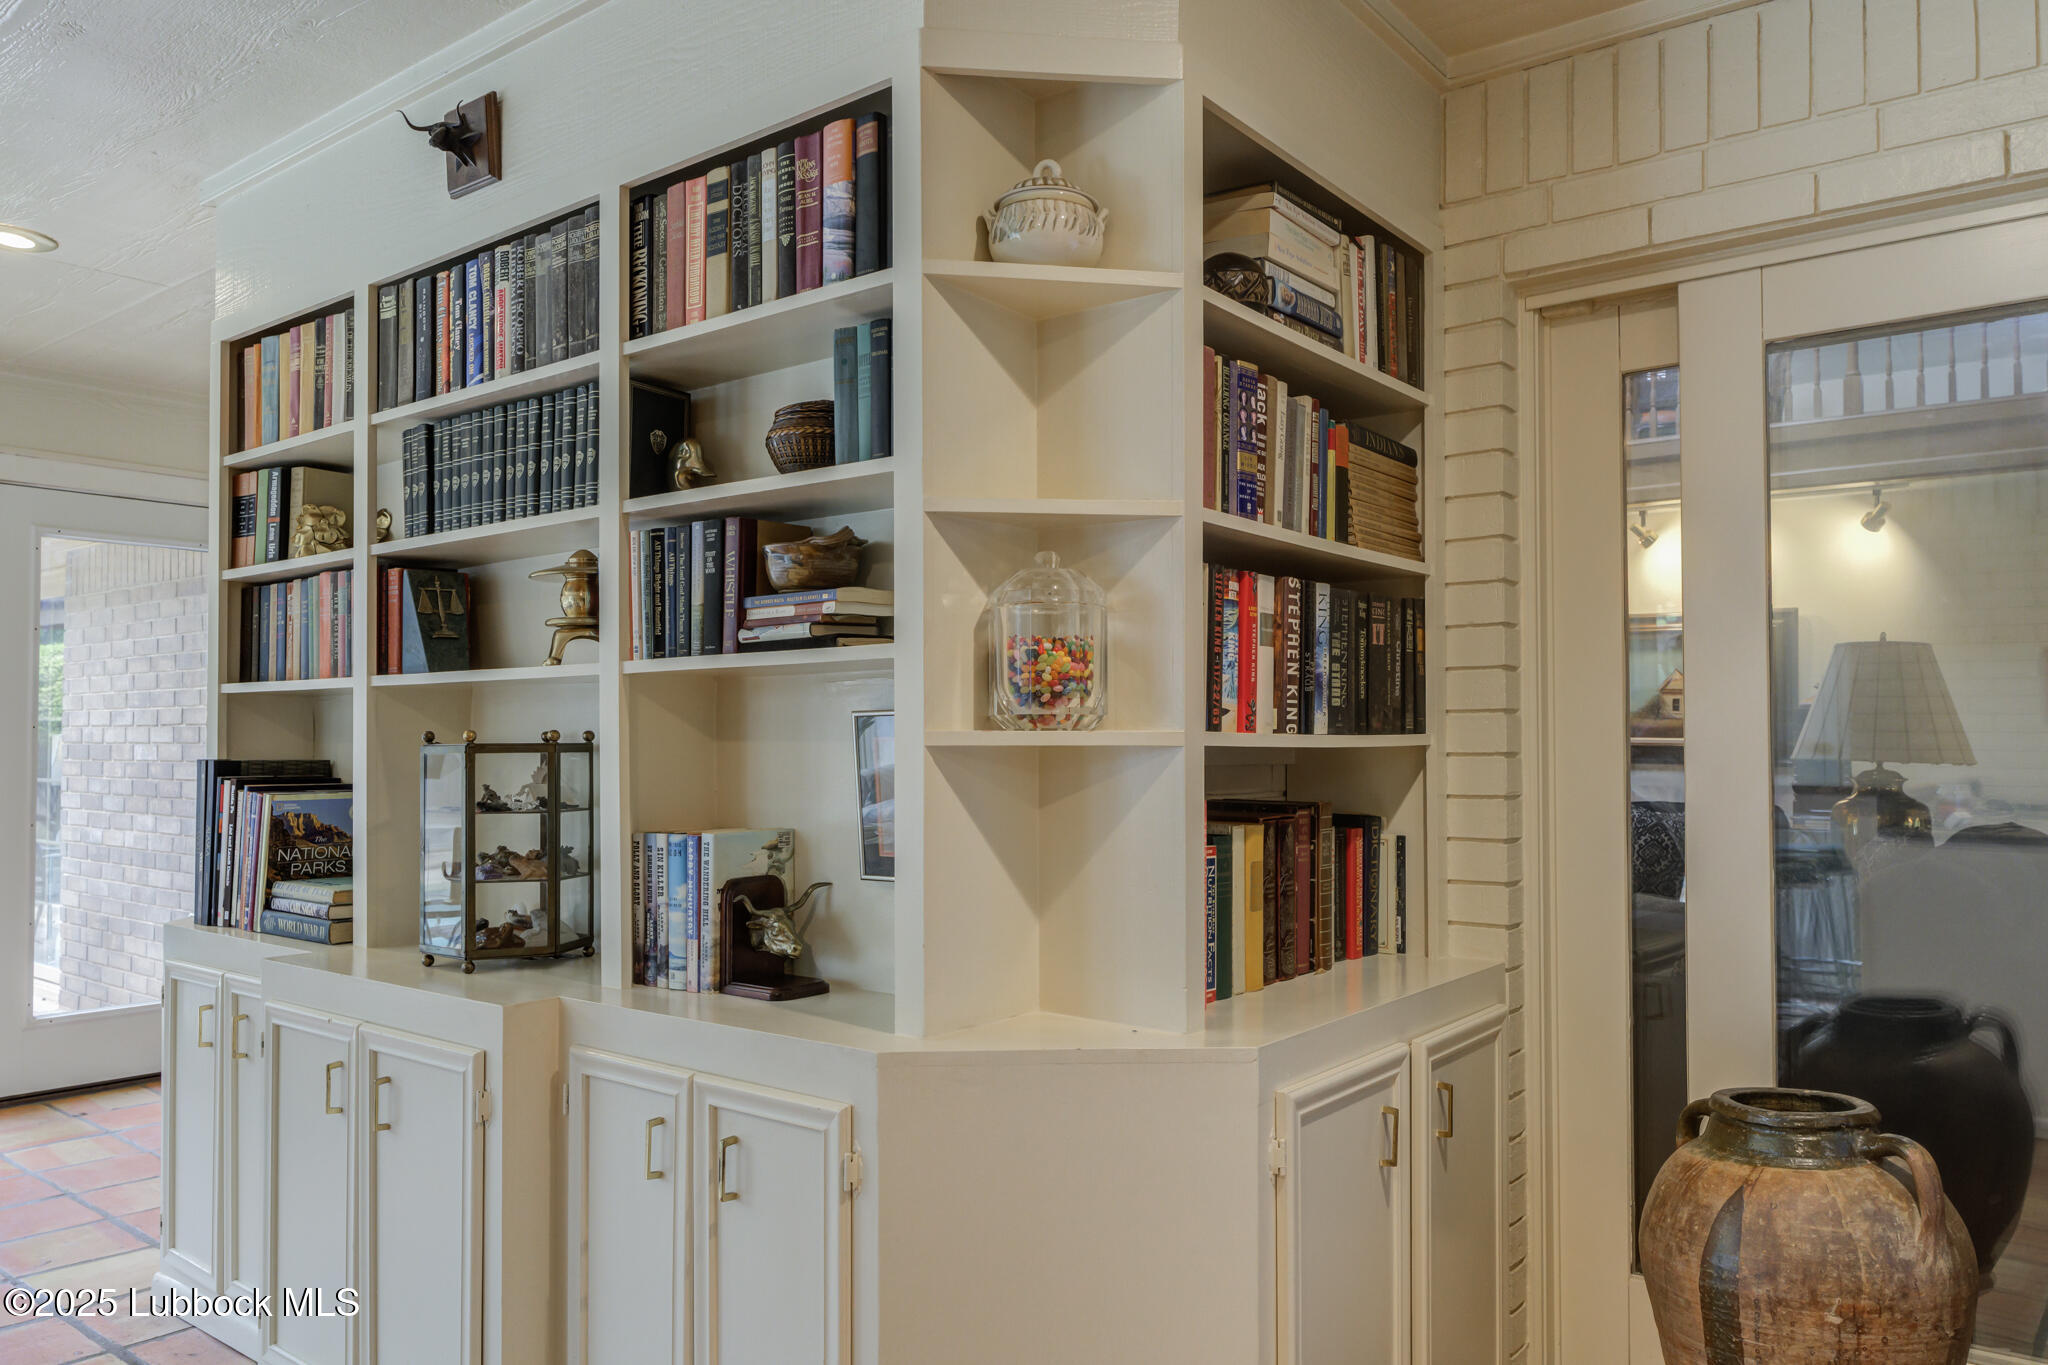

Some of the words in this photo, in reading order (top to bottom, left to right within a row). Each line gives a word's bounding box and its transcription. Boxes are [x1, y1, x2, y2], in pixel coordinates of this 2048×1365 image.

[633, 221, 643, 250] THE
[732, 184, 743, 258] DOCTORS
[468, 264, 478, 288] TOM
[499, 250, 510, 282] ROBERT
[632, 246, 648, 326] RECKONING
[454, 298, 463, 318] Tom
[468, 290, 478, 330] CLANCY
[454, 320, 463, 352] Clancy
[516, 303, 524, 355] SCORPIO
[1366, 431, 1405, 458] INDIANS
[270, 471, 279, 517] Armageddon
[268, 523, 276, 541] Leon
[268, 543, 276, 559] Uris
[724, 550, 736, 618] WHISTLE
[1214, 572, 1222, 622] STEPHEN
[654, 606, 662, 636] Beautiful
[1214, 625, 1222, 653] KING
[1286, 576, 1300, 676] STEPHEN
[1318, 592, 1328, 646] KING
[1331, 632, 1341, 657] THE
[1358, 628, 1367, 700] Tommyknockers
[1212, 664, 1221, 725] 11/22/63
[1286, 684, 1298, 735] KING
[278, 845, 353, 862] NATIONA
[290, 860, 346, 875] PARKS
[702, 860, 710, 906] WANDERING
[1206, 864, 1214, 940] NUTRITION
[1369, 825, 1380, 942] DICTIONARY
[278, 918, 303, 934] WORLD
[303, 922, 318, 937] WAR
[1206, 942, 1214, 984] FACTS
